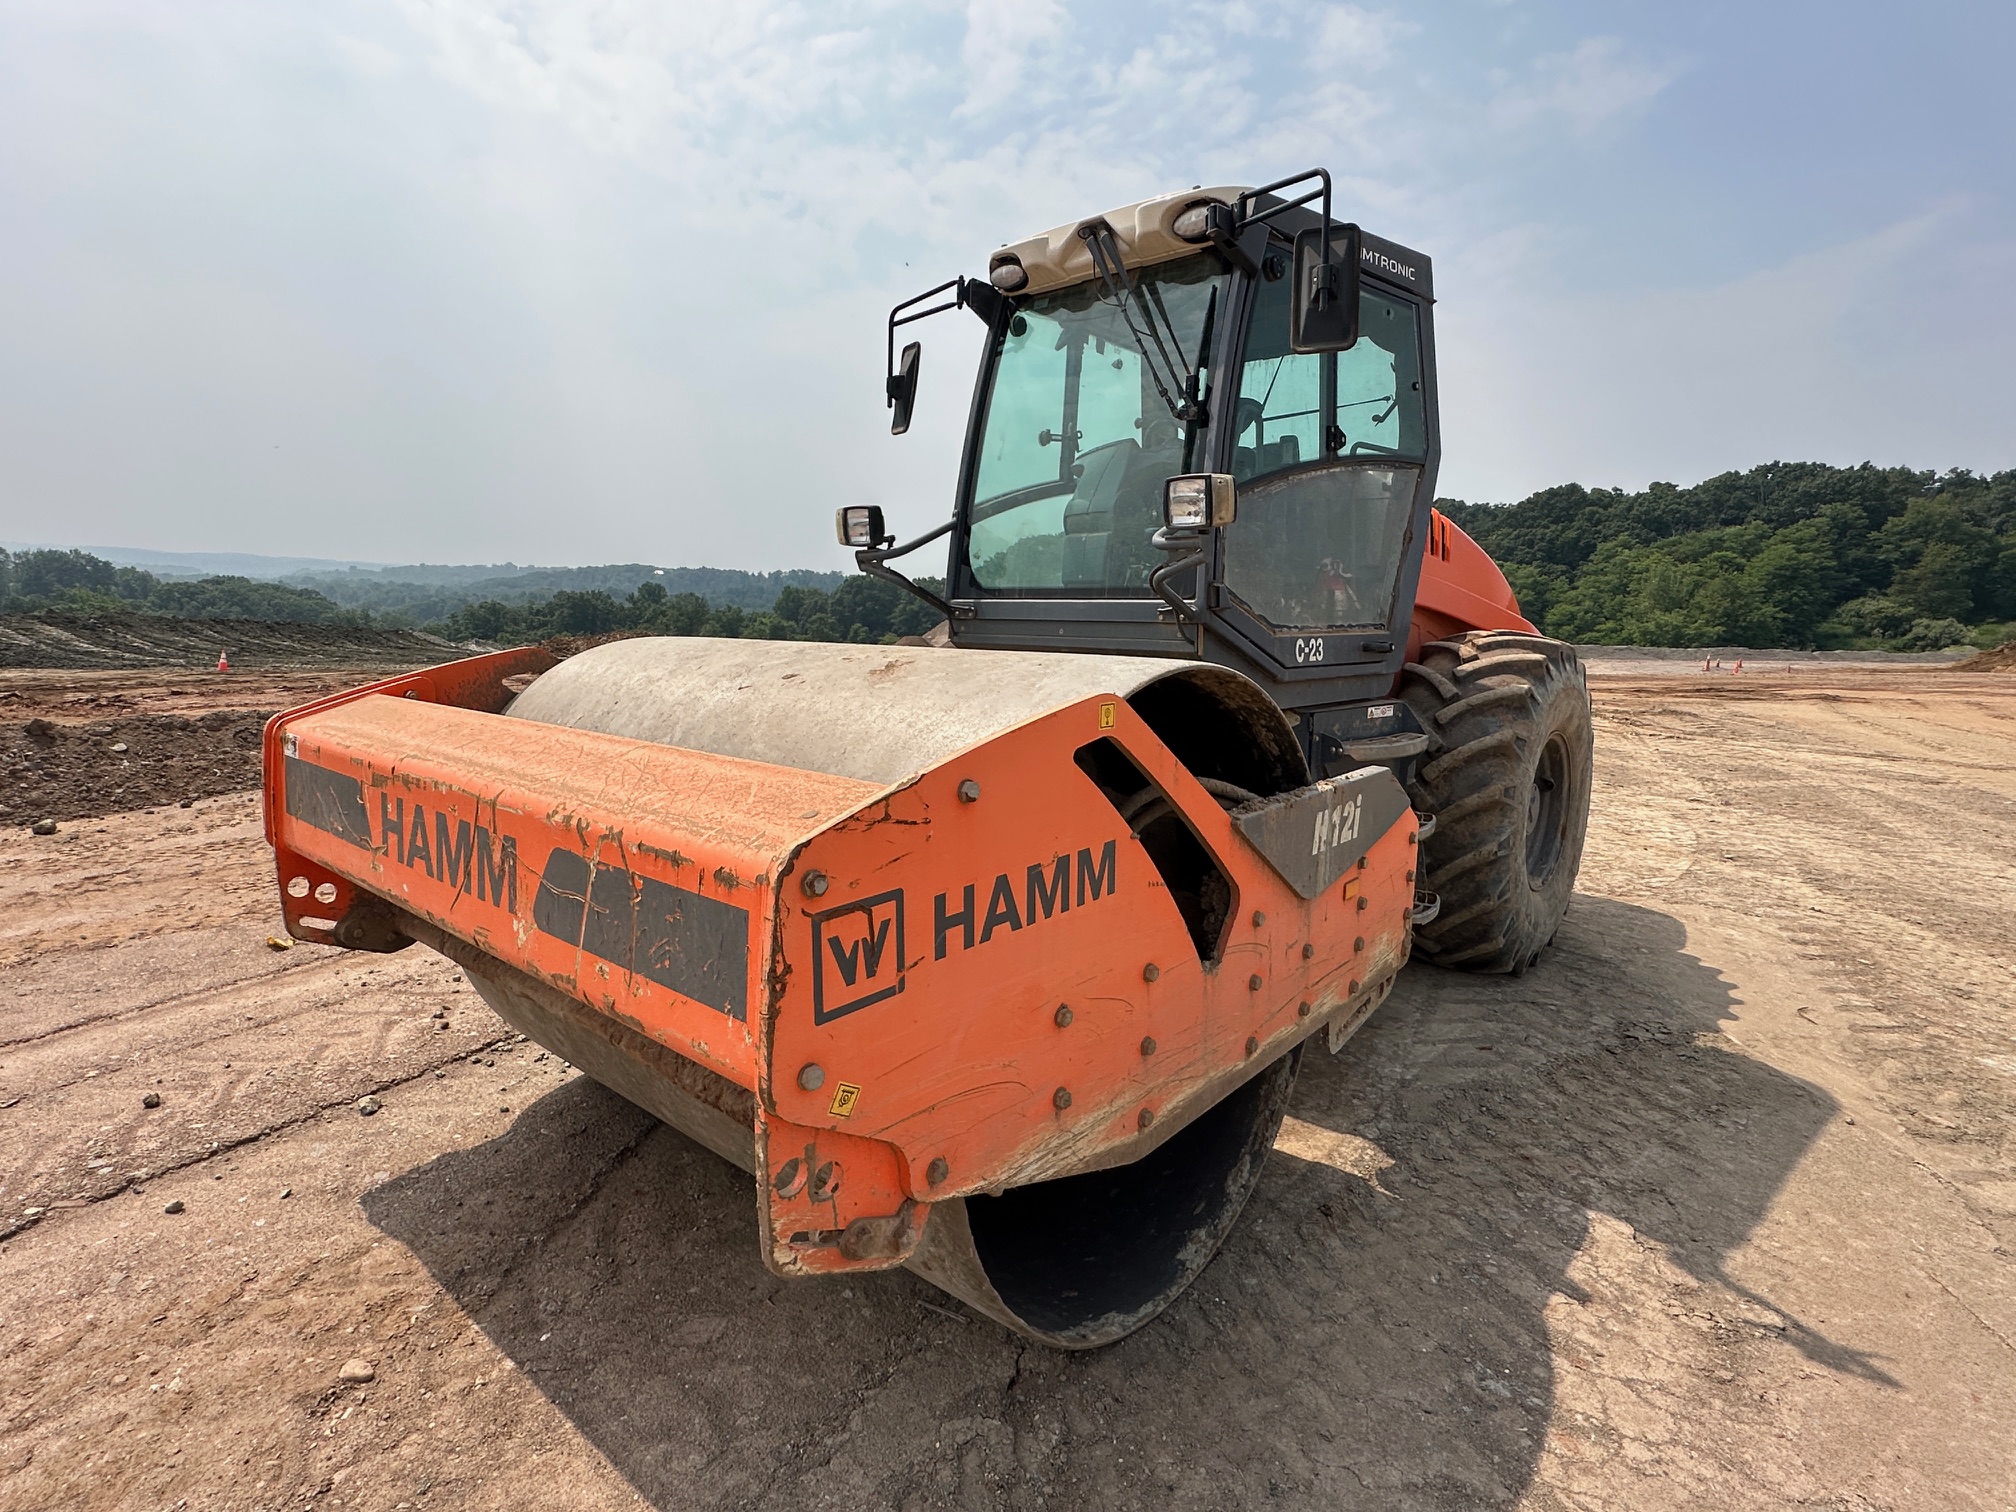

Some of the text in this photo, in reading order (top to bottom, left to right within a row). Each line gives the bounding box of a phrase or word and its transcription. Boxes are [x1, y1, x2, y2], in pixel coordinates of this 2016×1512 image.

[1360, 247, 1416, 281] MTRONIC
[1295, 637, 1324, 663] C-23
[380, 791, 517, 914] HAMM
[933, 839, 1117, 962] HAMM
